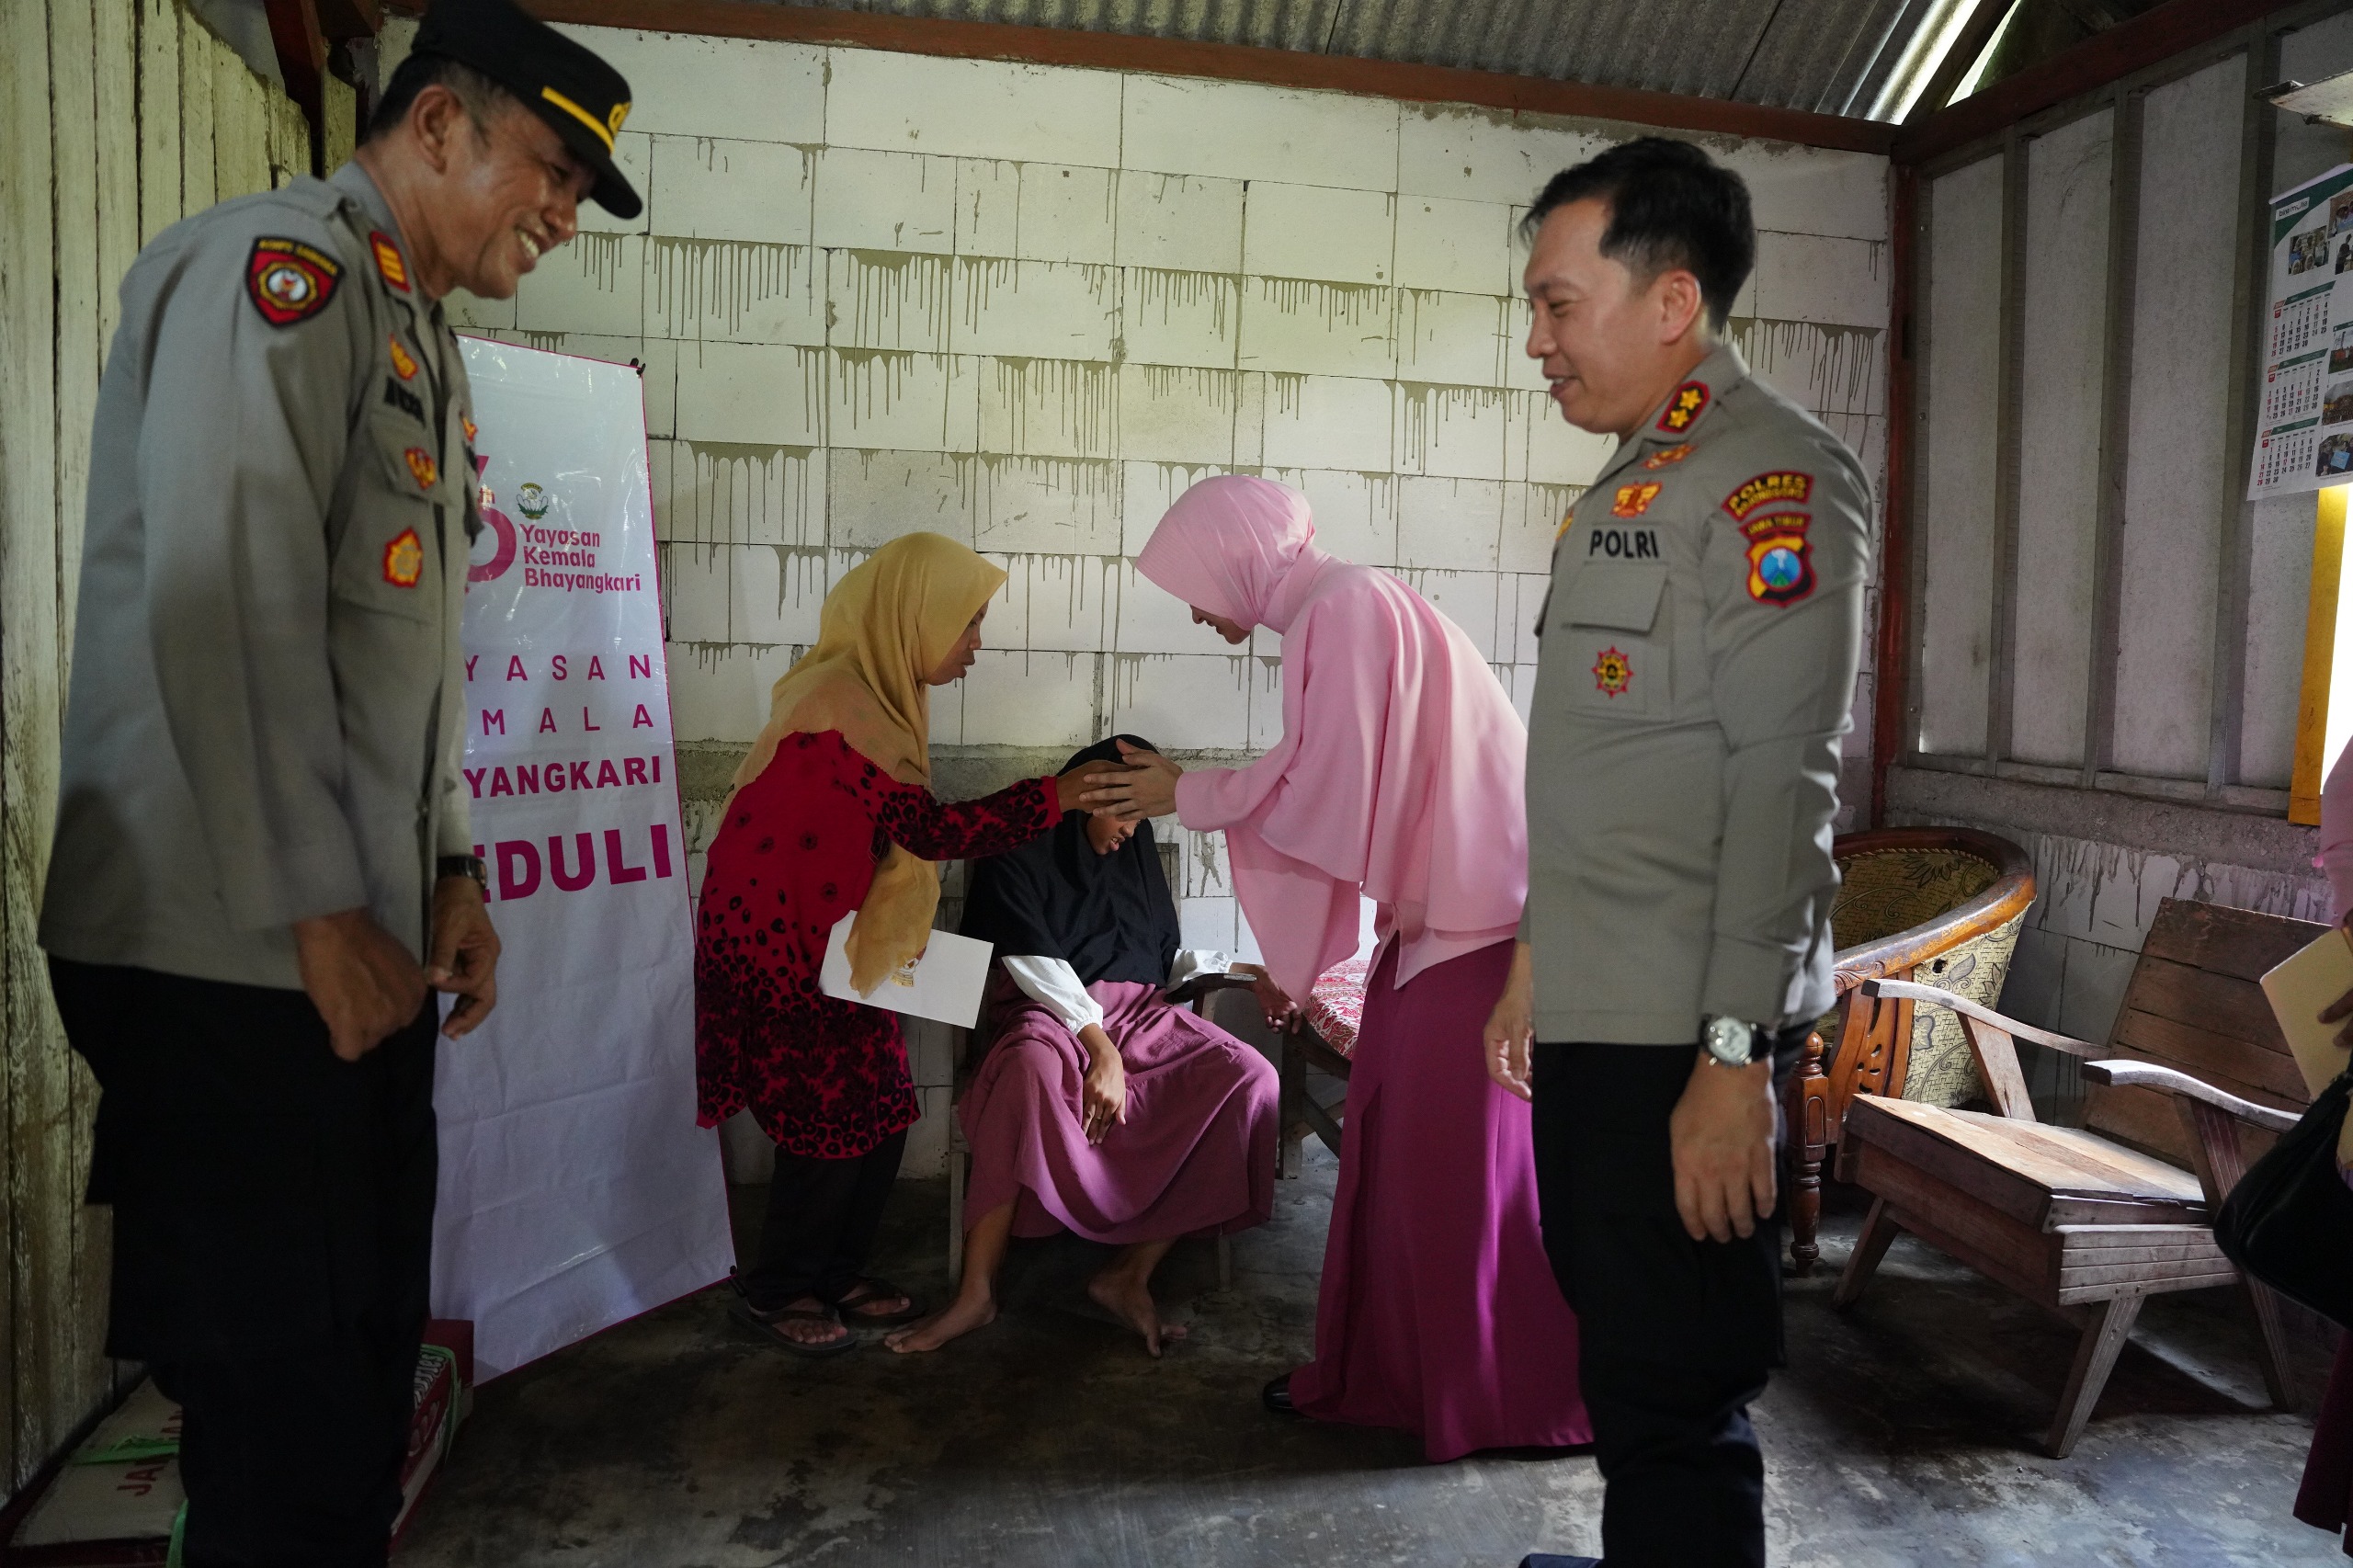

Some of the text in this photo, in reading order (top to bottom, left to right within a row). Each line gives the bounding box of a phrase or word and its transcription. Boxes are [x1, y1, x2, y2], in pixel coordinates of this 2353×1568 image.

[1729, 474, 1806, 509] POLRES
[519, 523, 600, 548] Yayasan
[1589, 529, 1660, 559] POLRI
[523, 546, 596, 568] Kemala
[525, 568, 642, 594] Bhayangkari
[462, 756, 661, 799] YANGKARI
